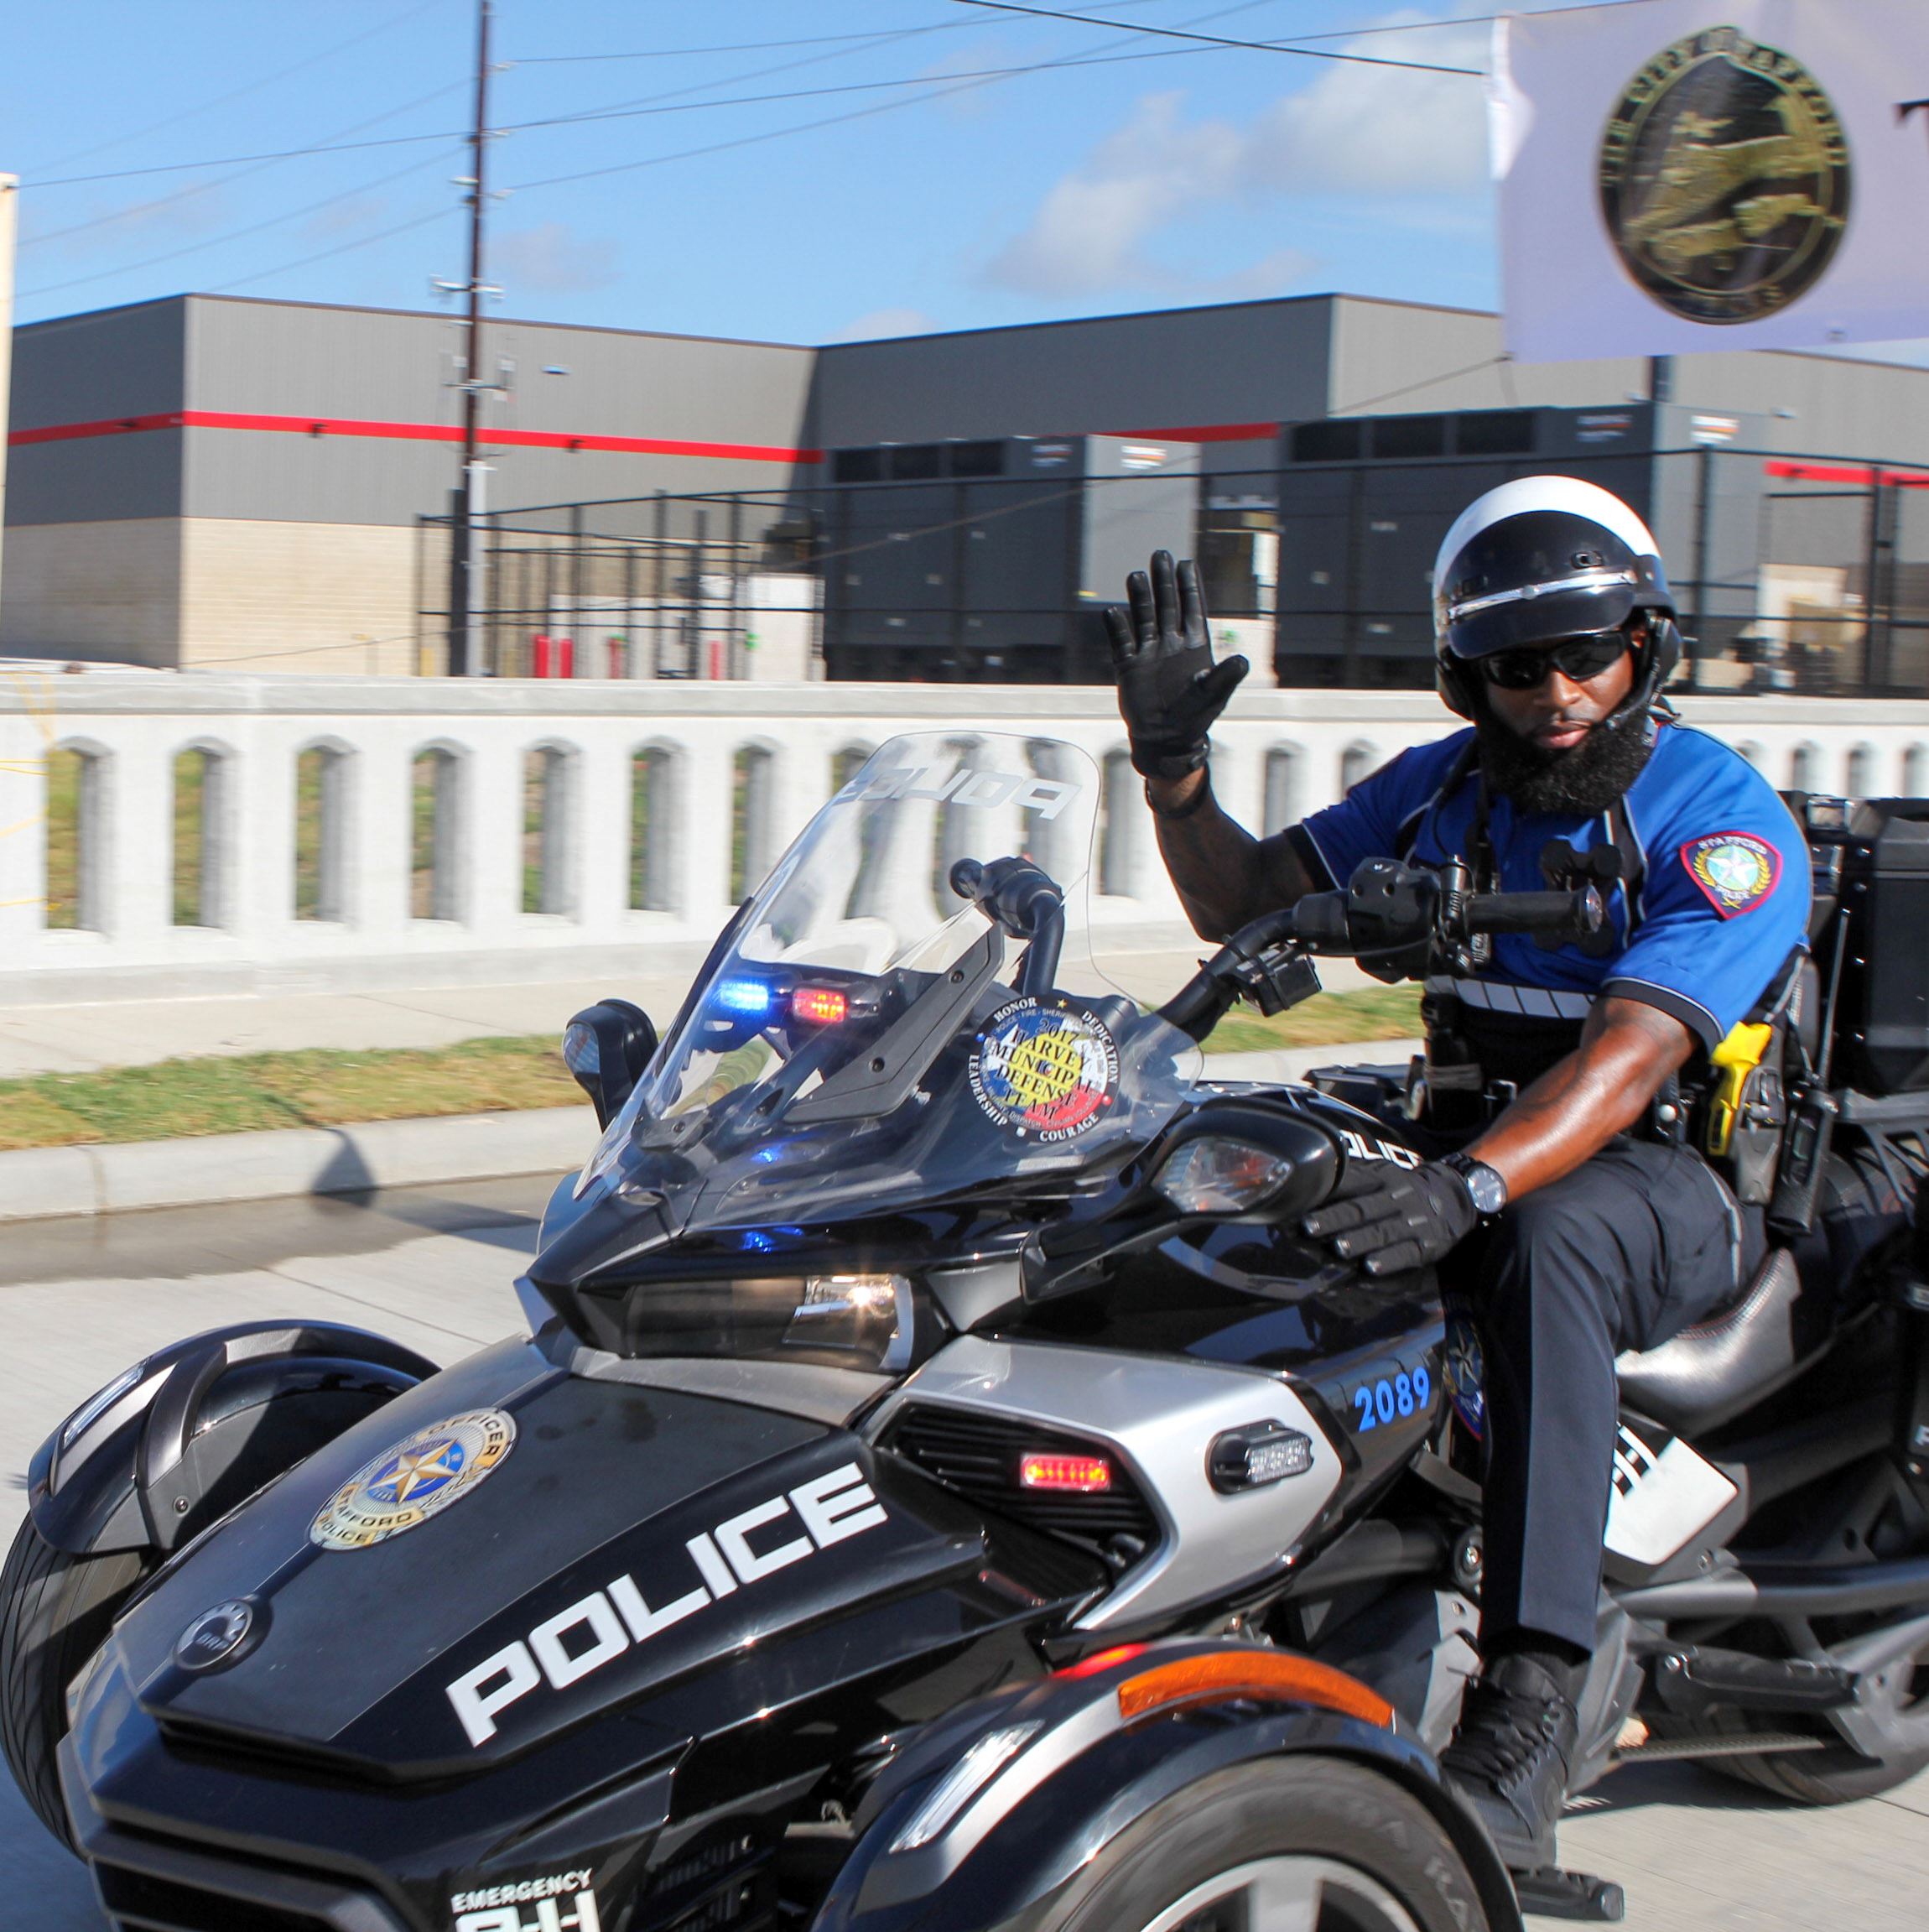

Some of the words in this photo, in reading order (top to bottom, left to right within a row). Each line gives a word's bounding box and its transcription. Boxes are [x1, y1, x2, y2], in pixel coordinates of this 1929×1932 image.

[993, 997, 1037, 1022] HONOR
[1011, 1028, 1091, 1070] HARVEY
[1035, 1018, 1080, 1045] 2017
[1082, 1010, 1119, 1084] DEDICATION
[991, 1042, 1094, 1094] MUNICIPAL
[996, 1064, 1079, 1108] DEFENSE
[968, 1055, 1008, 1127] LEADERSHIP
[1004, 1086, 1058, 1121] TEAM
[1039, 1112, 1100, 1143] COURAGE
[1354, 1366, 1431, 1433] 2089
[319, 1514, 367, 1544] POLICE
[336, 1488, 412, 1527] STAFFORD
[445, 1461, 889, 1748] POLICE
[450, 1867, 593, 1914] EMERGENCY
